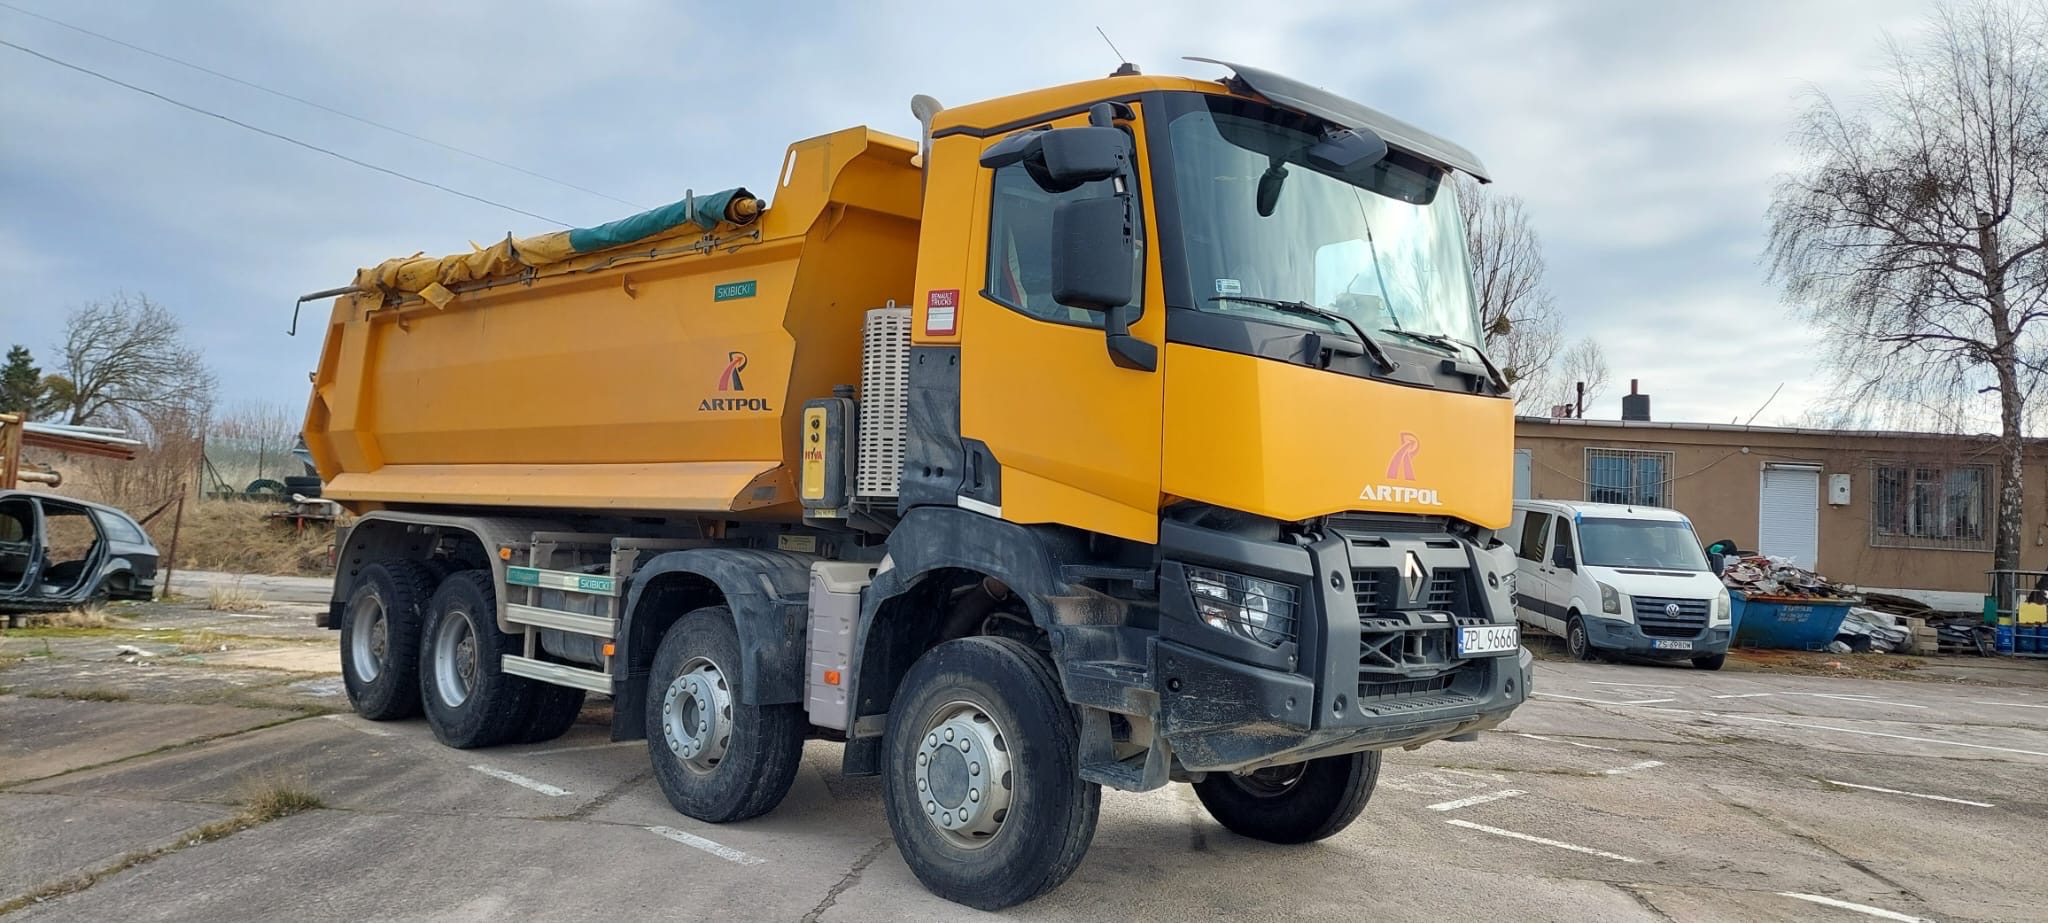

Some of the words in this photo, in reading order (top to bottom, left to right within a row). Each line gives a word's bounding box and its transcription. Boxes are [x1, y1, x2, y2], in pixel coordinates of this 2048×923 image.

[717, 283, 751, 299] SKIBICKI
[698, 398, 773, 411] ARTPOL
[805, 447, 823, 460] HYVA
[1359, 484, 1443, 506] ARTPOL
[580, 579, 610, 590] SKIBICKI
[1464, 630, 1484, 650] ZPL
[1487, 628, 1518, 650] 96660
